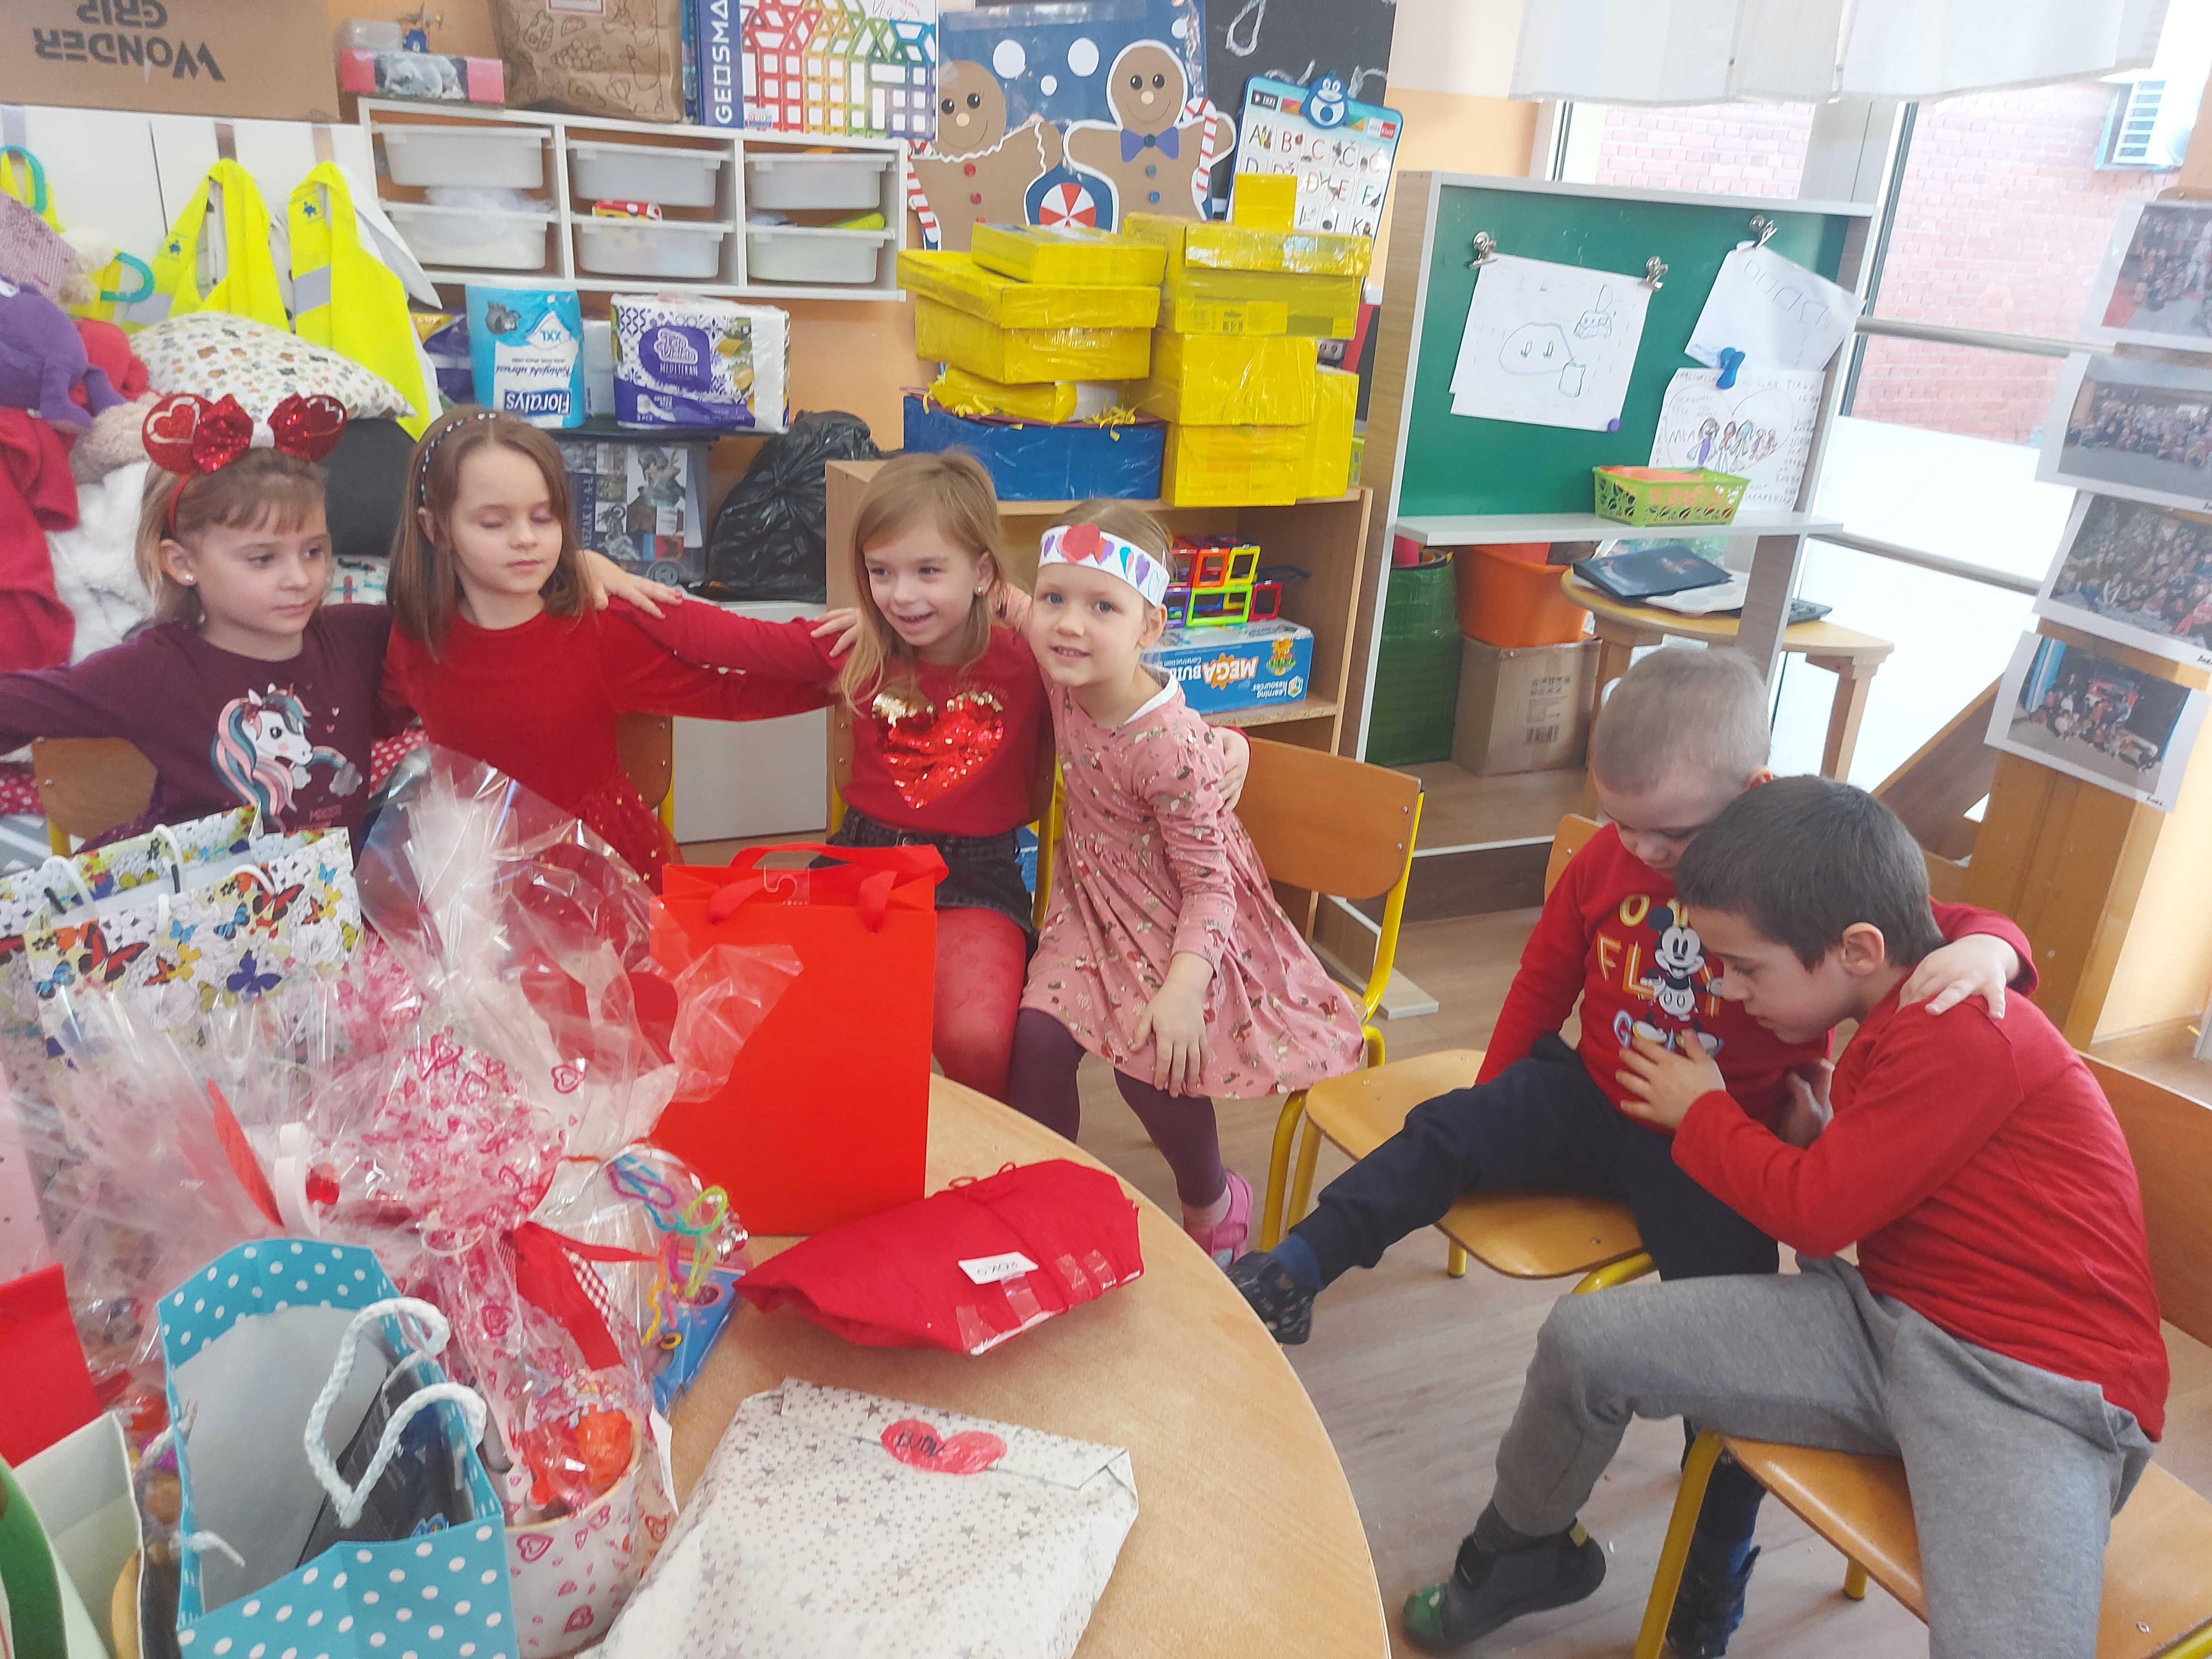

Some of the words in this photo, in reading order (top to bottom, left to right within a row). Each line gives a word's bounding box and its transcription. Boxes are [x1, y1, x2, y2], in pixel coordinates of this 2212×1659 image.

[77, 0, 167, 28] GRIP
[33, 27, 225, 82] WONDER
[1282, 131, 1292, 153] B
[1312, 139, 1325, 160] C
[1337, 178, 1349, 202] E
[1362, 184, 1374, 206] F
[541, 330, 562, 342] XXL
[506, 391, 570, 414] Floralys
[1668, 427, 1695, 445] MIA
[1169, 664, 1202, 682] BUIL
[1202, 656, 1259, 684] MEGA
[1252, 680, 1288, 692] Resources
[1256, 688, 1287, 699] Learning
